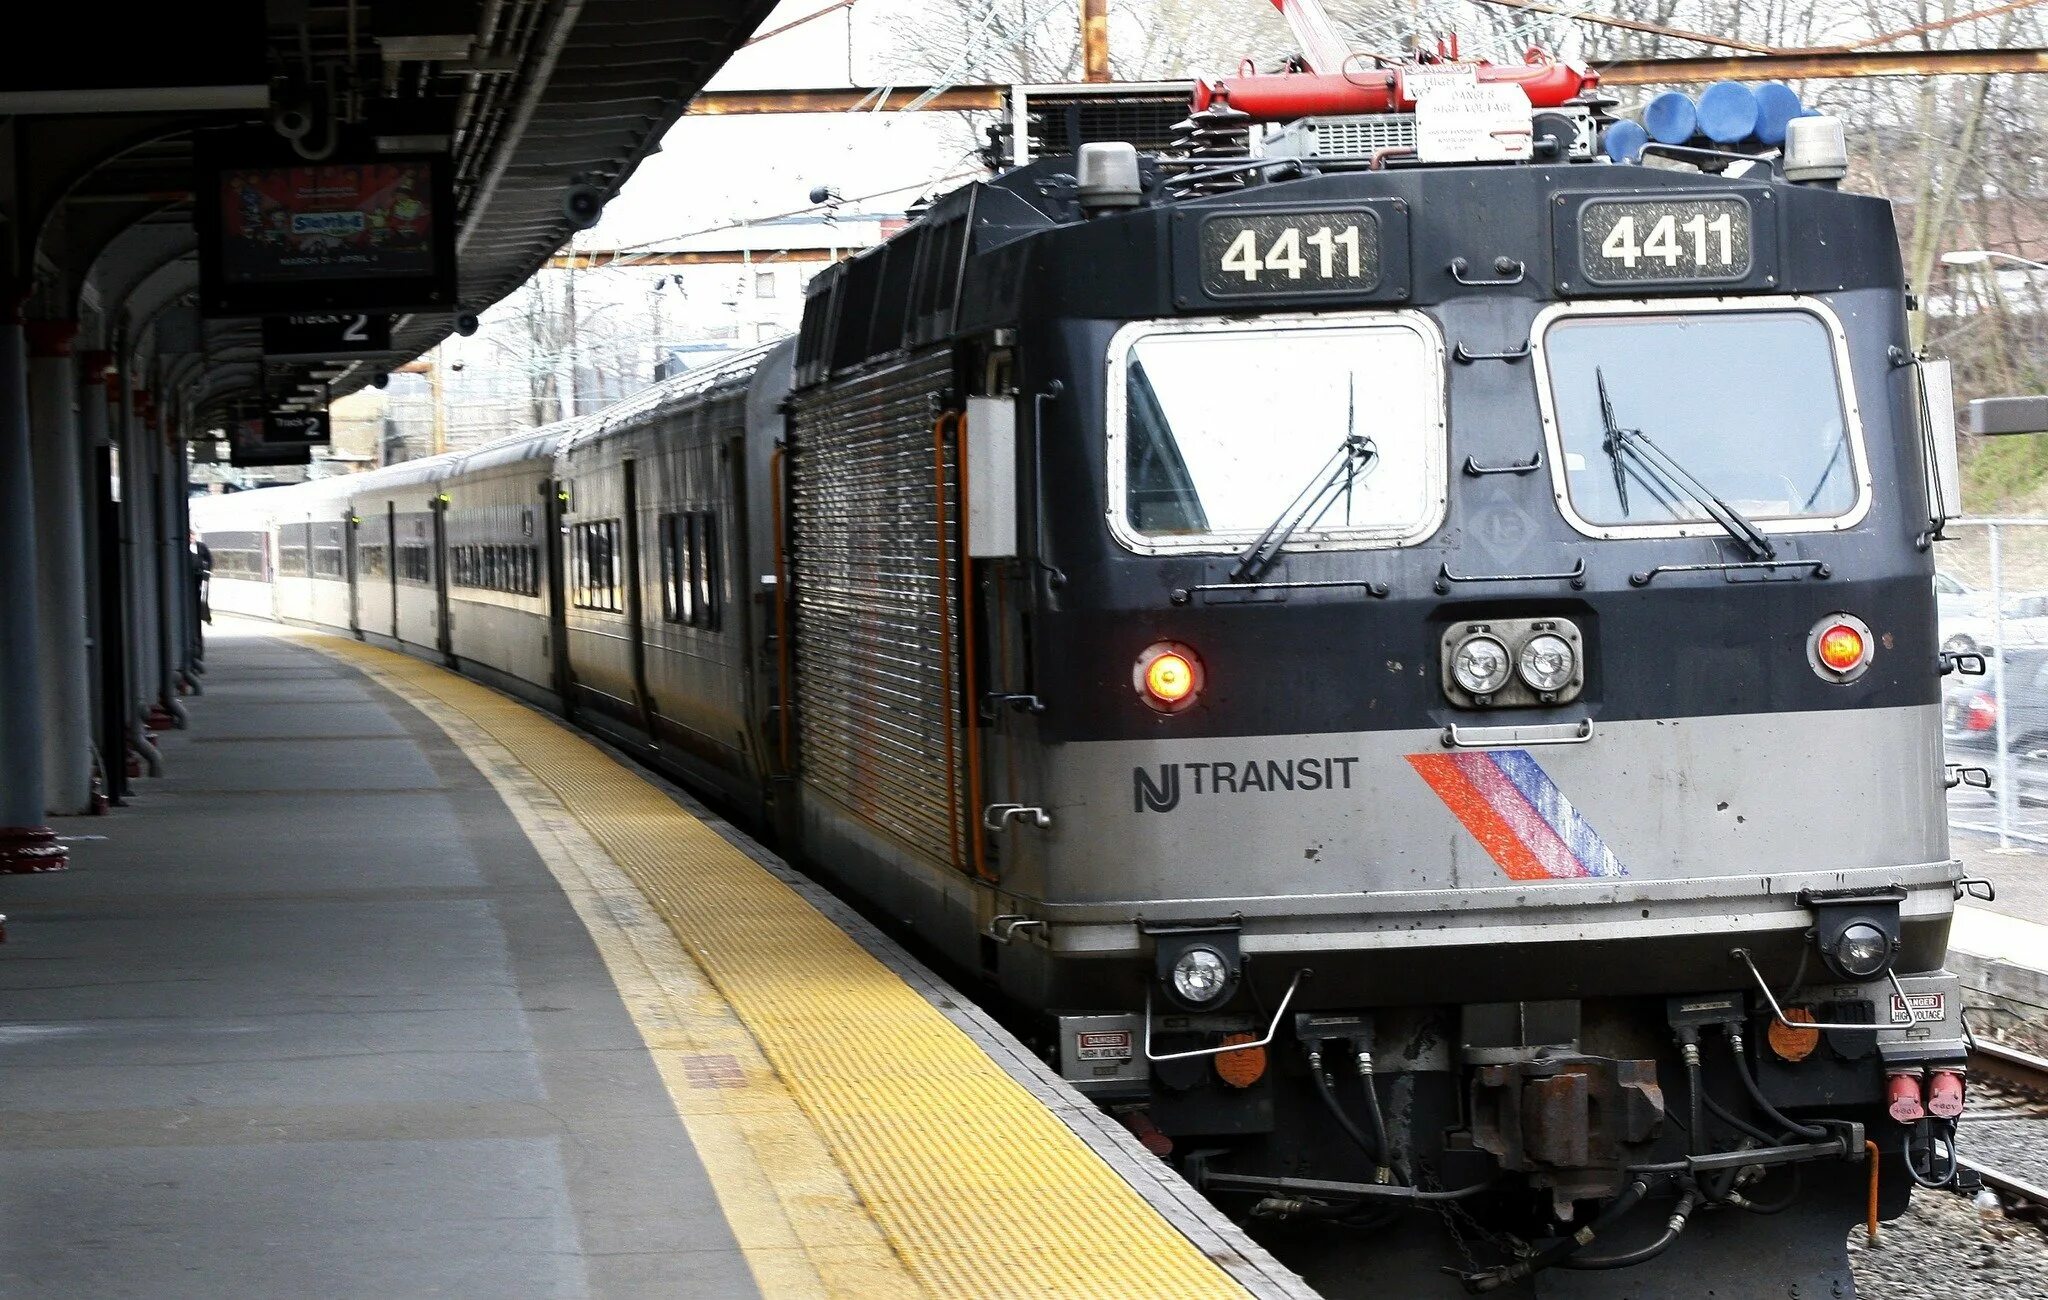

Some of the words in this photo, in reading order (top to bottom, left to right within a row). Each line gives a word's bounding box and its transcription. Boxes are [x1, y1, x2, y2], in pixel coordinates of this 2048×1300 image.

[1602, 213, 1732, 267] 4411
[280, 256, 319, 266] MARCH
[339, 254, 370, 264] APRIL
[1221, 226, 1361, 280] 4411
[342, 314, 369, 341] 2
[274, 417, 304, 428] Track
[304, 416, 322, 436] 2
[1132, 764, 1181, 813] NJ
[1185, 757, 1359, 794] TRANSIT
[1914, 1010, 1941, 1020] VOLTAGE
[1087, 1036, 1122, 1044] DANGER
[1081, 1049, 1097, 1058] HIGH
[1100, 1048, 1128, 1057] VOLTAGE
